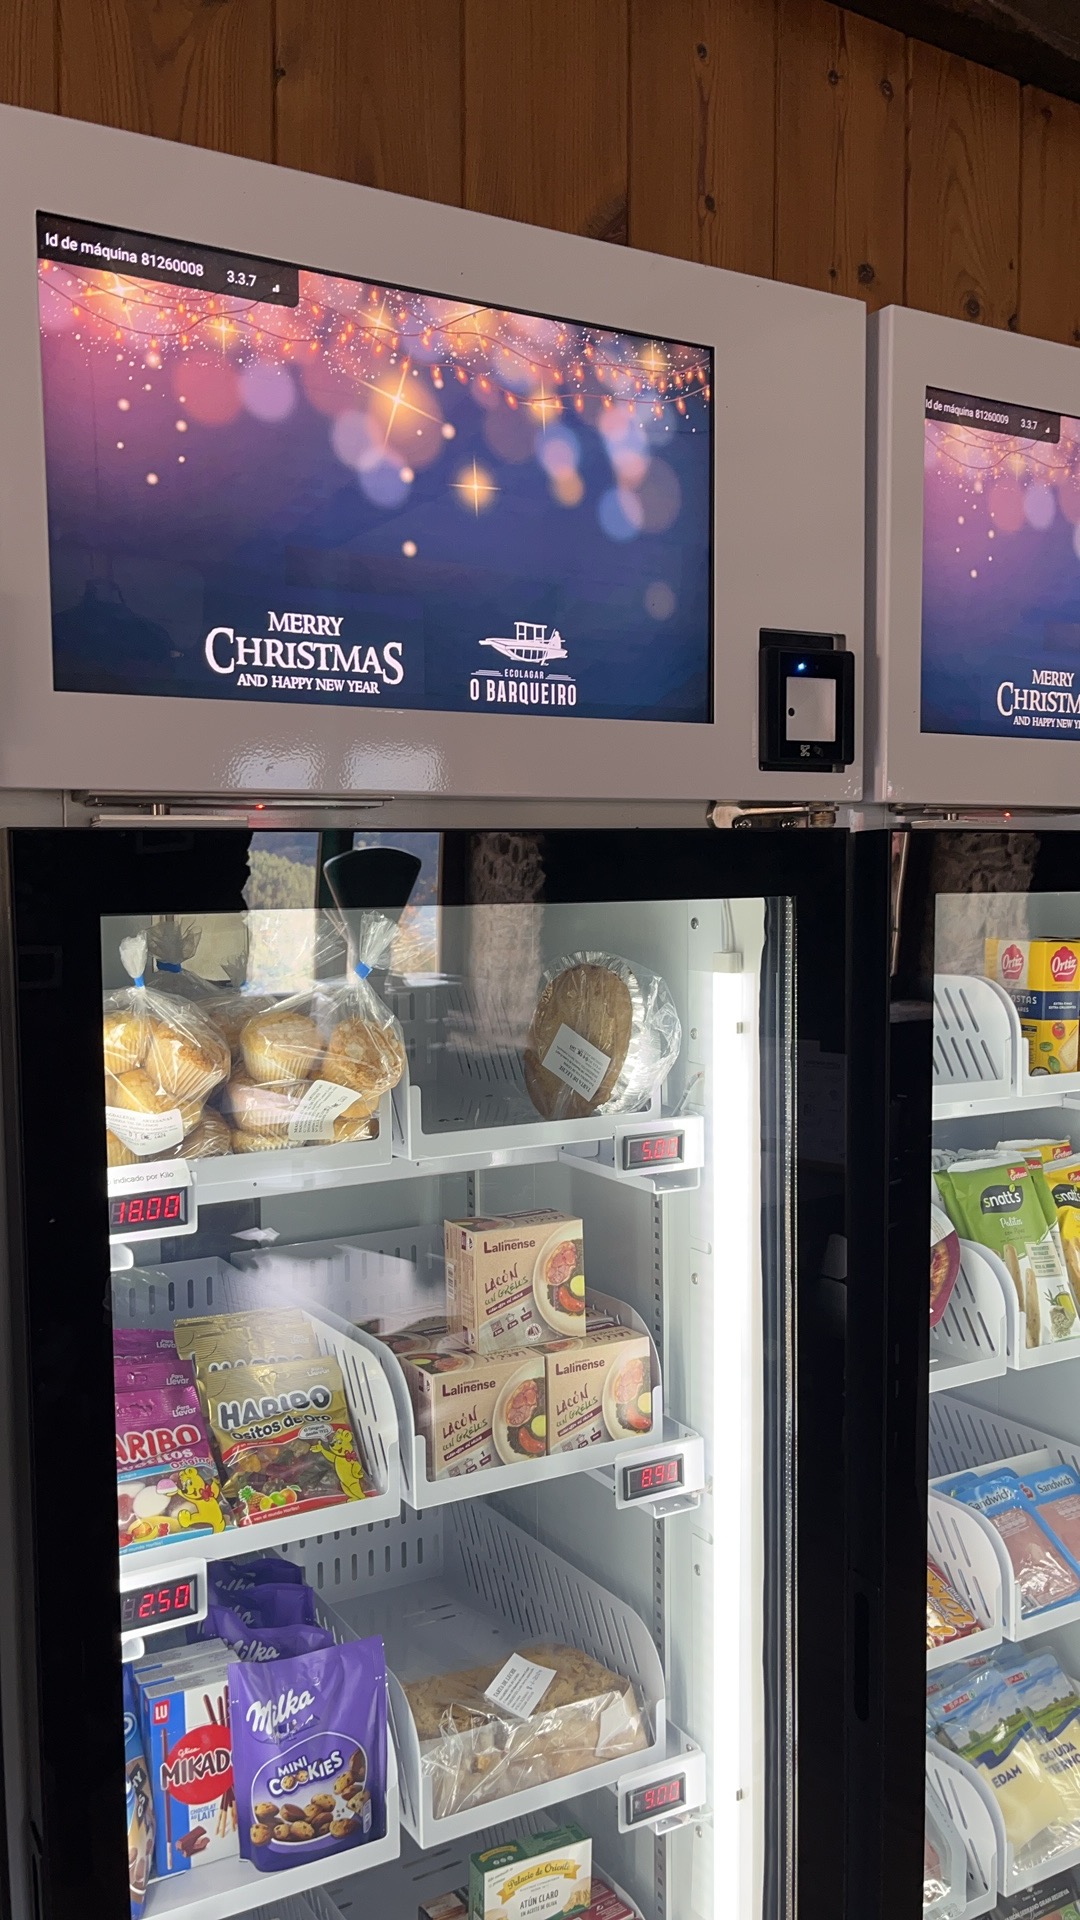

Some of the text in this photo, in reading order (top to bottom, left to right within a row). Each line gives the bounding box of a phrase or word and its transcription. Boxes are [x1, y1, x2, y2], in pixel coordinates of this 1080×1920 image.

[45, 232, 257, 288] Id de máquina 81260008 3.3.7
[926, 398, 1038, 430] Id de máquina 81260009 3.3.7
[268, 611, 344, 637] MERRY
[205, 627, 404, 685] CHRISTMAS
[236, 673, 380, 695] AND HAPPY NEW YEAR
[504, 669, 545, 680] ECOLAGAR
[1031, 669, 1075, 687] MERRY
[469, 678, 577, 706] O BARQUEIRO
[997, 681, 1080, 716] CHRISTM
[1013, 715, 1031, 726] AND
[1032, 717, 1056, 728] HAPPY
[1056, 718, 1074, 729] NEW
[1002, 953, 1023, 971] Ortiz
[1052, 955, 1078, 974] Ortiz
[641, 1135, 679, 1162] 5.00
[113, 1174, 145, 1185] indicado
[146, 1174, 158, 1183] por
[160, 1171, 175, 1179] Kilo
[119, 1195, 180, 1224] 18.00
[483, 1237, 536, 1254] Lalinense
[484, 1262, 518, 1294] LACÓN
[156, 1341, 176, 1349] Lleva
[555, 1359, 605, 1376] Lalinense
[166, 1376, 189, 1386] Llevar
[442, 1380, 496, 1397] Lalinense
[218, 1386, 332, 1430] HARIBO
[556, 1382, 589, 1416] LACÓN
[172, 1406, 196, 1418] Llevar
[442, 1404, 477, 1439] LACÓN
[232, 1414, 332, 1440] Ositos de Oro
[116, 1424, 201, 1464] ARIBO
[640, 1460, 679, 1488] 8.90
[1036, 1475, 1074, 1494] Sandwich
[137, 1582, 191, 1620] 2.50
[154, 1704, 168, 1720] LU
[246, 1688, 315, 1735] Milka
[948, 1693, 970, 1710] SPAR
[160, 1748, 232, 1790] MIKAD
[276, 1755, 309, 1778] MINI
[991, 1764, 1022, 1789] EDAM
[644, 1780, 681, 1810] 9.00
[197, 1809, 217, 1822] LAIT
[508, 1871, 534, 1890] Palacio
[535, 1867, 543, 1877] de
[520, 1889, 559, 1910] ATÚN CLARO
